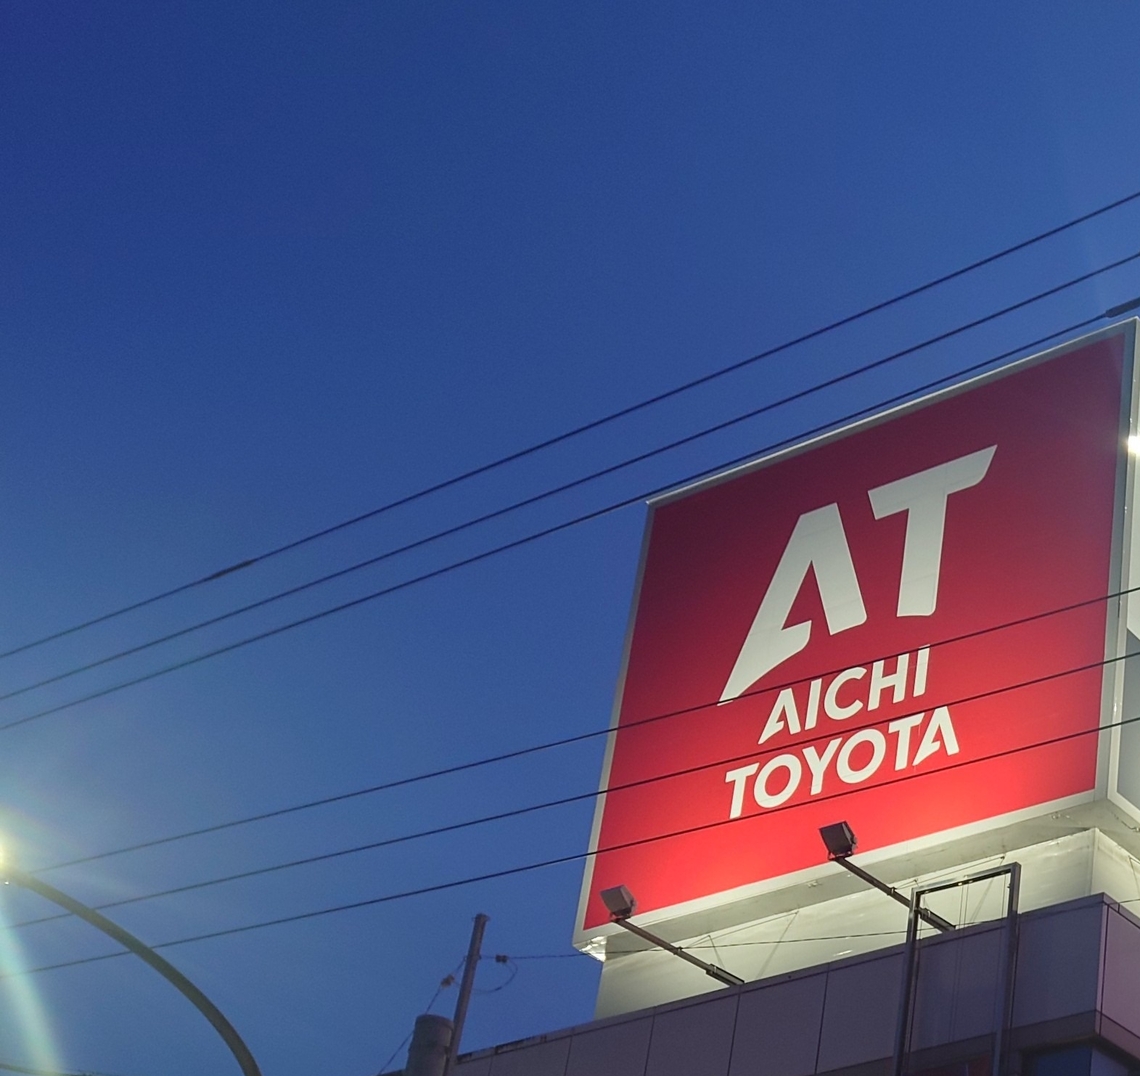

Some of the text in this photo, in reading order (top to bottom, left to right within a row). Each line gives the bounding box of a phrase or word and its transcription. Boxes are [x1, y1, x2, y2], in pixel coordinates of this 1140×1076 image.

[717, 444, 998, 706] AT
[758, 644, 930, 745] AICHI
[725, 706, 959, 820] TOYOTA
